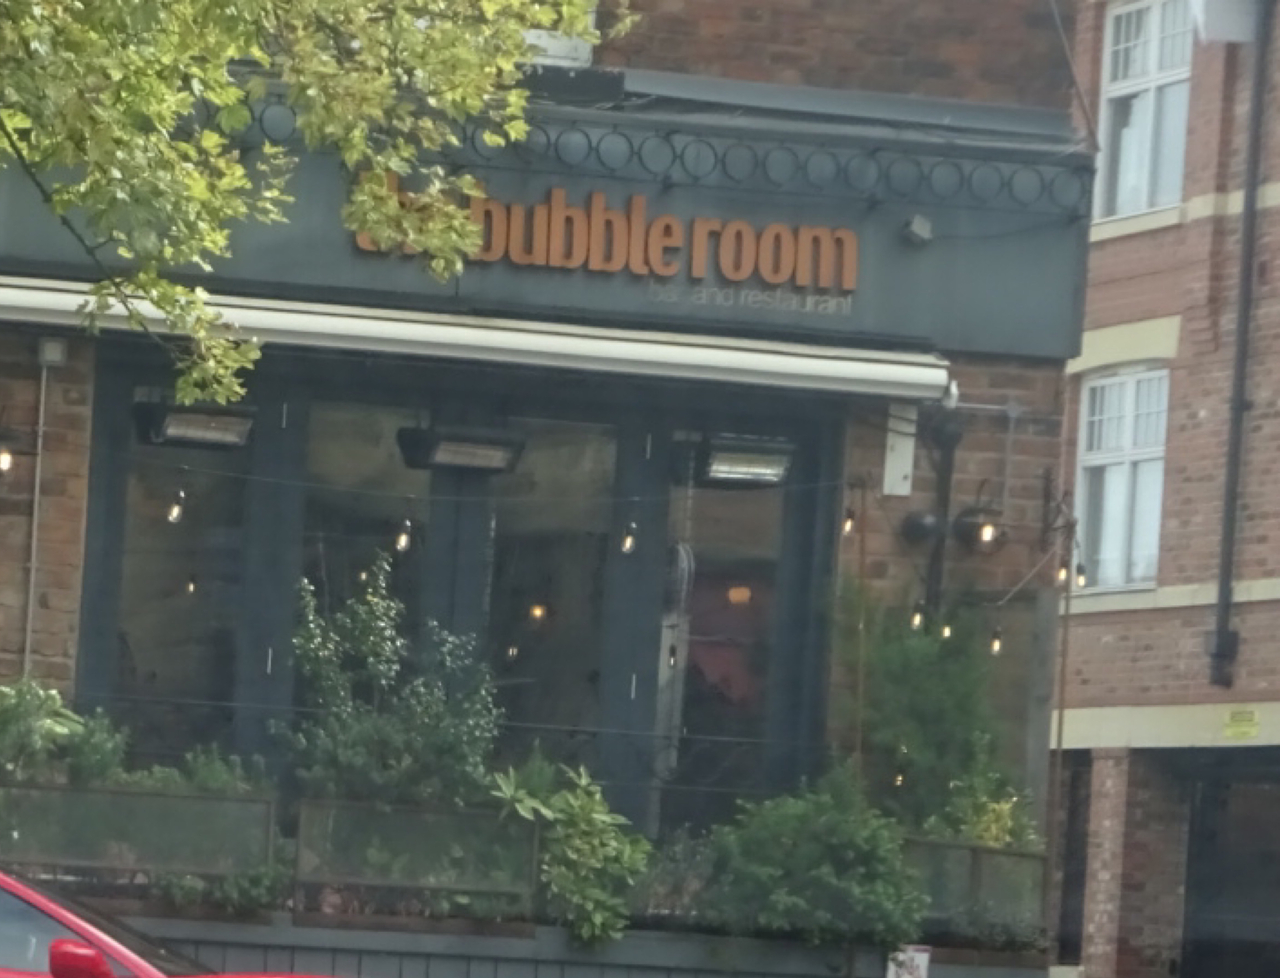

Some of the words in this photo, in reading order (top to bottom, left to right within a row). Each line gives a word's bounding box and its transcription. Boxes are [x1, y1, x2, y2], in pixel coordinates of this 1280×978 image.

[469, 184, 684, 277] bubble
[690, 215, 858, 291] room
[648, 278, 679, 303] ba
[692, 284, 734, 306] and
[739, 286, 853, 316] restaurant
